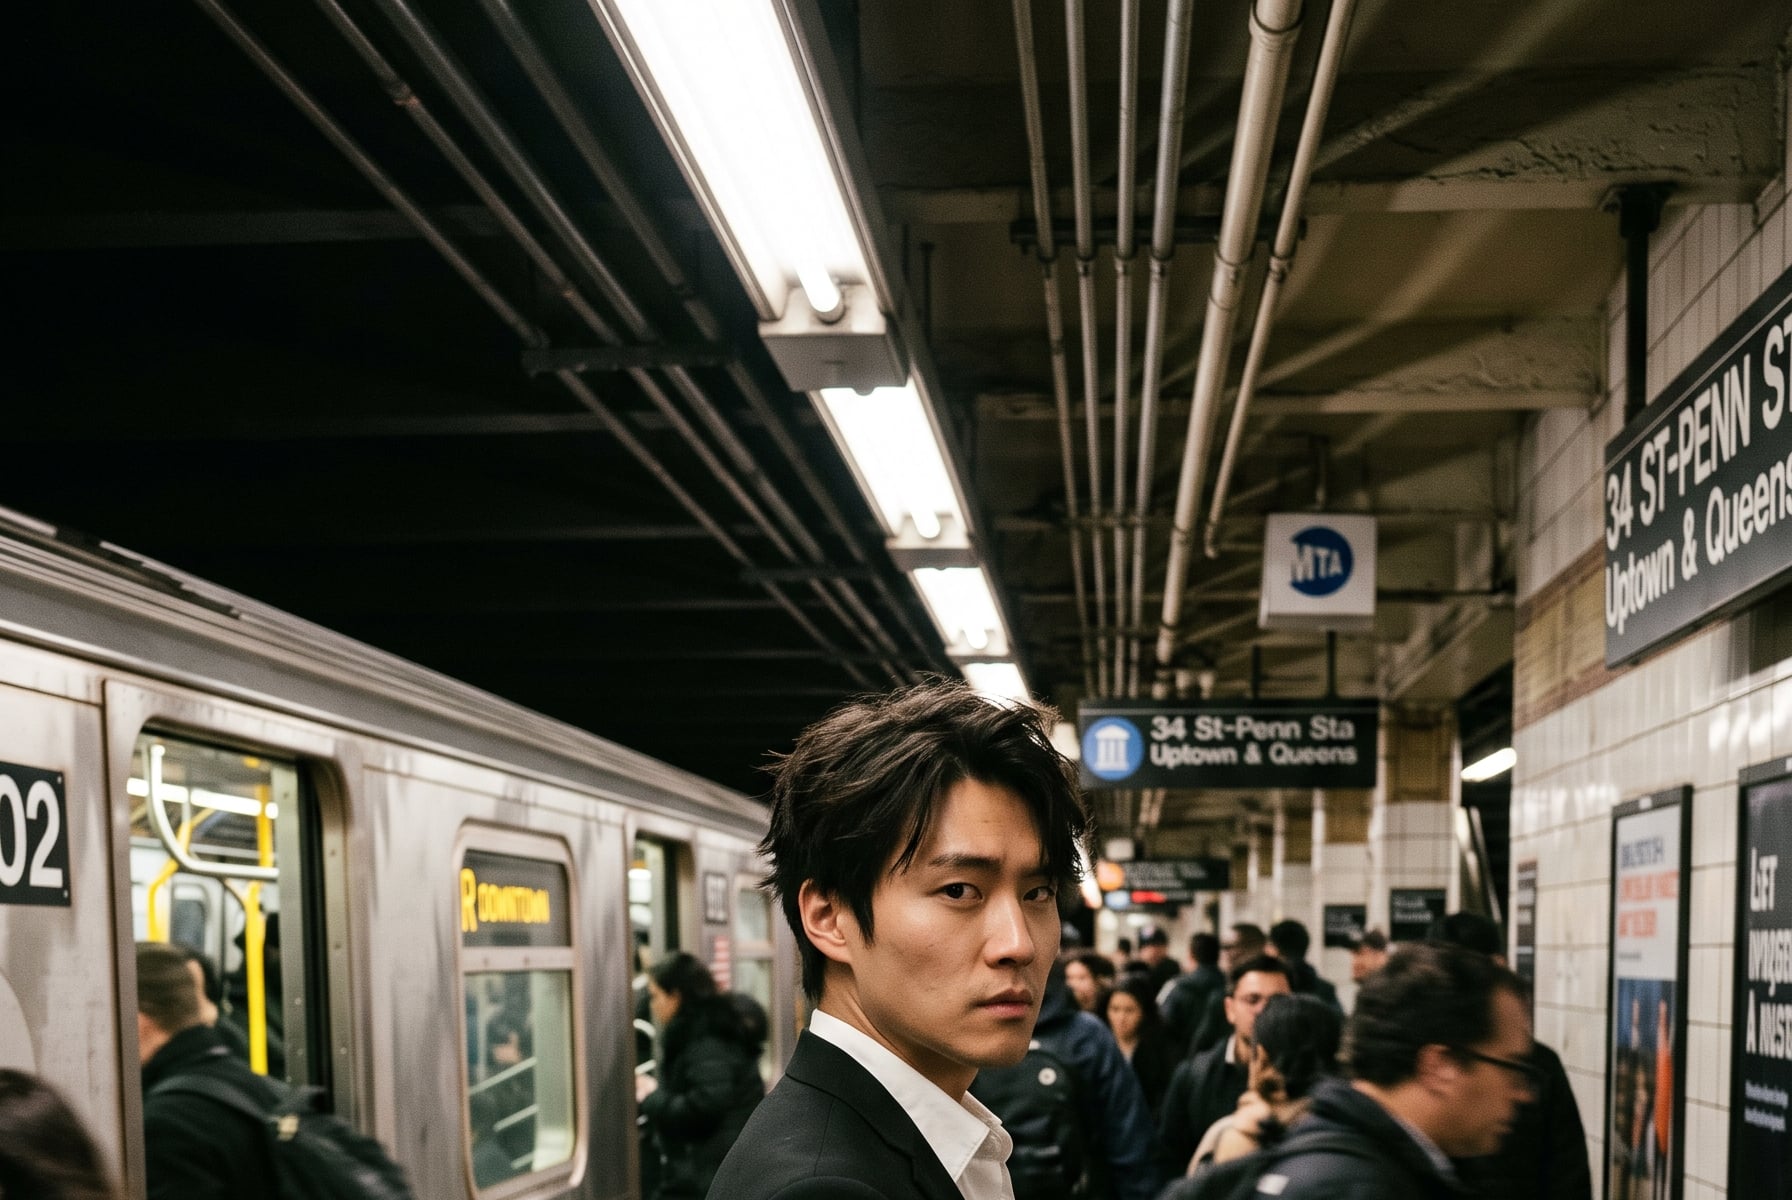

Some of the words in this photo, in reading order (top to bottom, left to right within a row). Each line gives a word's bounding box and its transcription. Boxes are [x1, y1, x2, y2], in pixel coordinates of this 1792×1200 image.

[1606, 461, 1633, 550] 34
[1640, 354, 1750, 526] ST-PENN
[1290, 542, 1343, 582] MTA
[1605, 539, 1675, 635] Uptown
[1681, 507, 1698, 581] &
[1150, 743, 1238, 769] Uptown
[1243, 742, 1262, 766] &
[1269, 742, 1358, 766] Queens
[1151, 715, 1187, 740] 34
[1194, 714, 1301, 740] St-Penn
[1310, 715, 1355, 740] Sta
[0, 773, 63, 888] 02
[461, 867, 478, 933] R
